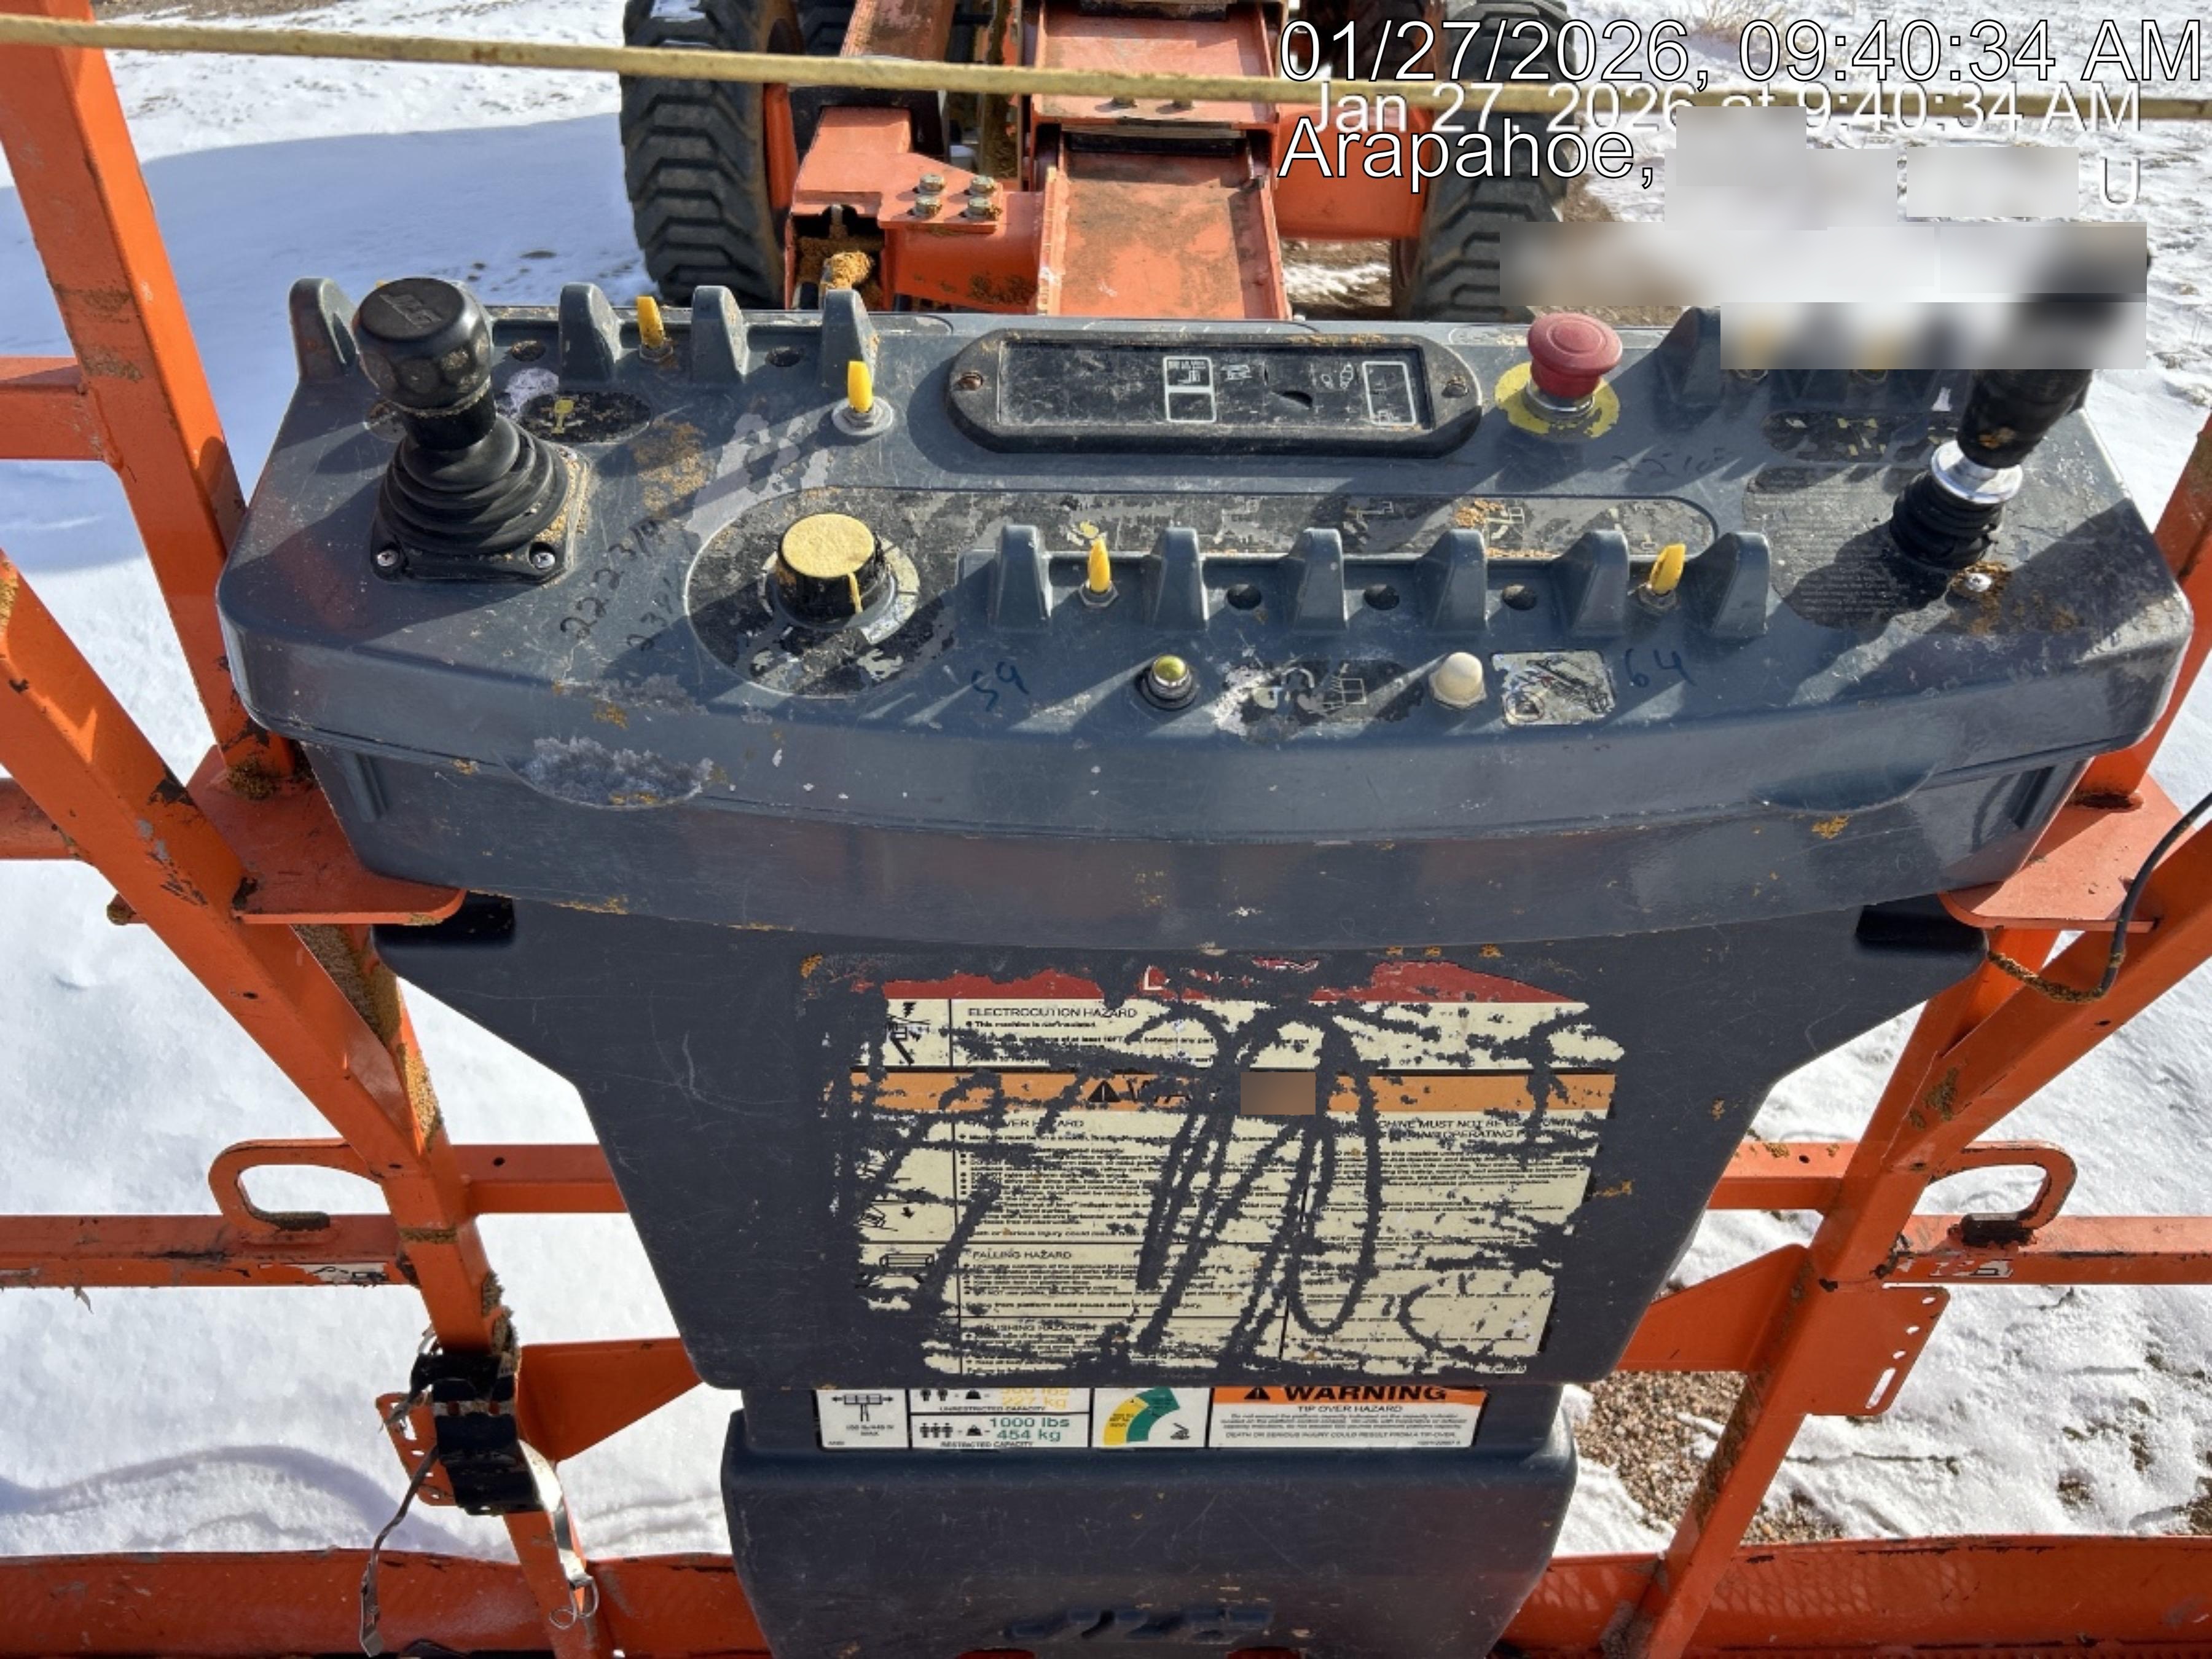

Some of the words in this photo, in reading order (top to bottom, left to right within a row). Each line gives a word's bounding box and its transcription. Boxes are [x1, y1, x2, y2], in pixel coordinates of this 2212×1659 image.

[1625, 648, 1696, 689] 64
[968, 1007, 1081, 1017] ELECTROCUTION
[1083, 1008, 1137, 1018] HAZARD
[1033, 1119, 1085, 1128] HARD
[973, 1250, 1021, 1259] FALLING
[1024, 1250, 1072, 1259] HAZARD
[1284, 1386, 1446, 1402] WARNING
[1002, 1397, 1035, 1406] 227
[1045, 1395, 1067, 1410] kg
[989, 1418, 1035, 1427] 1000
[1041, 1417, 1070, 1427] lbs
[997, 1430, 1031, 1440] 454
[1038, 1428, 1061, 1441] kg
